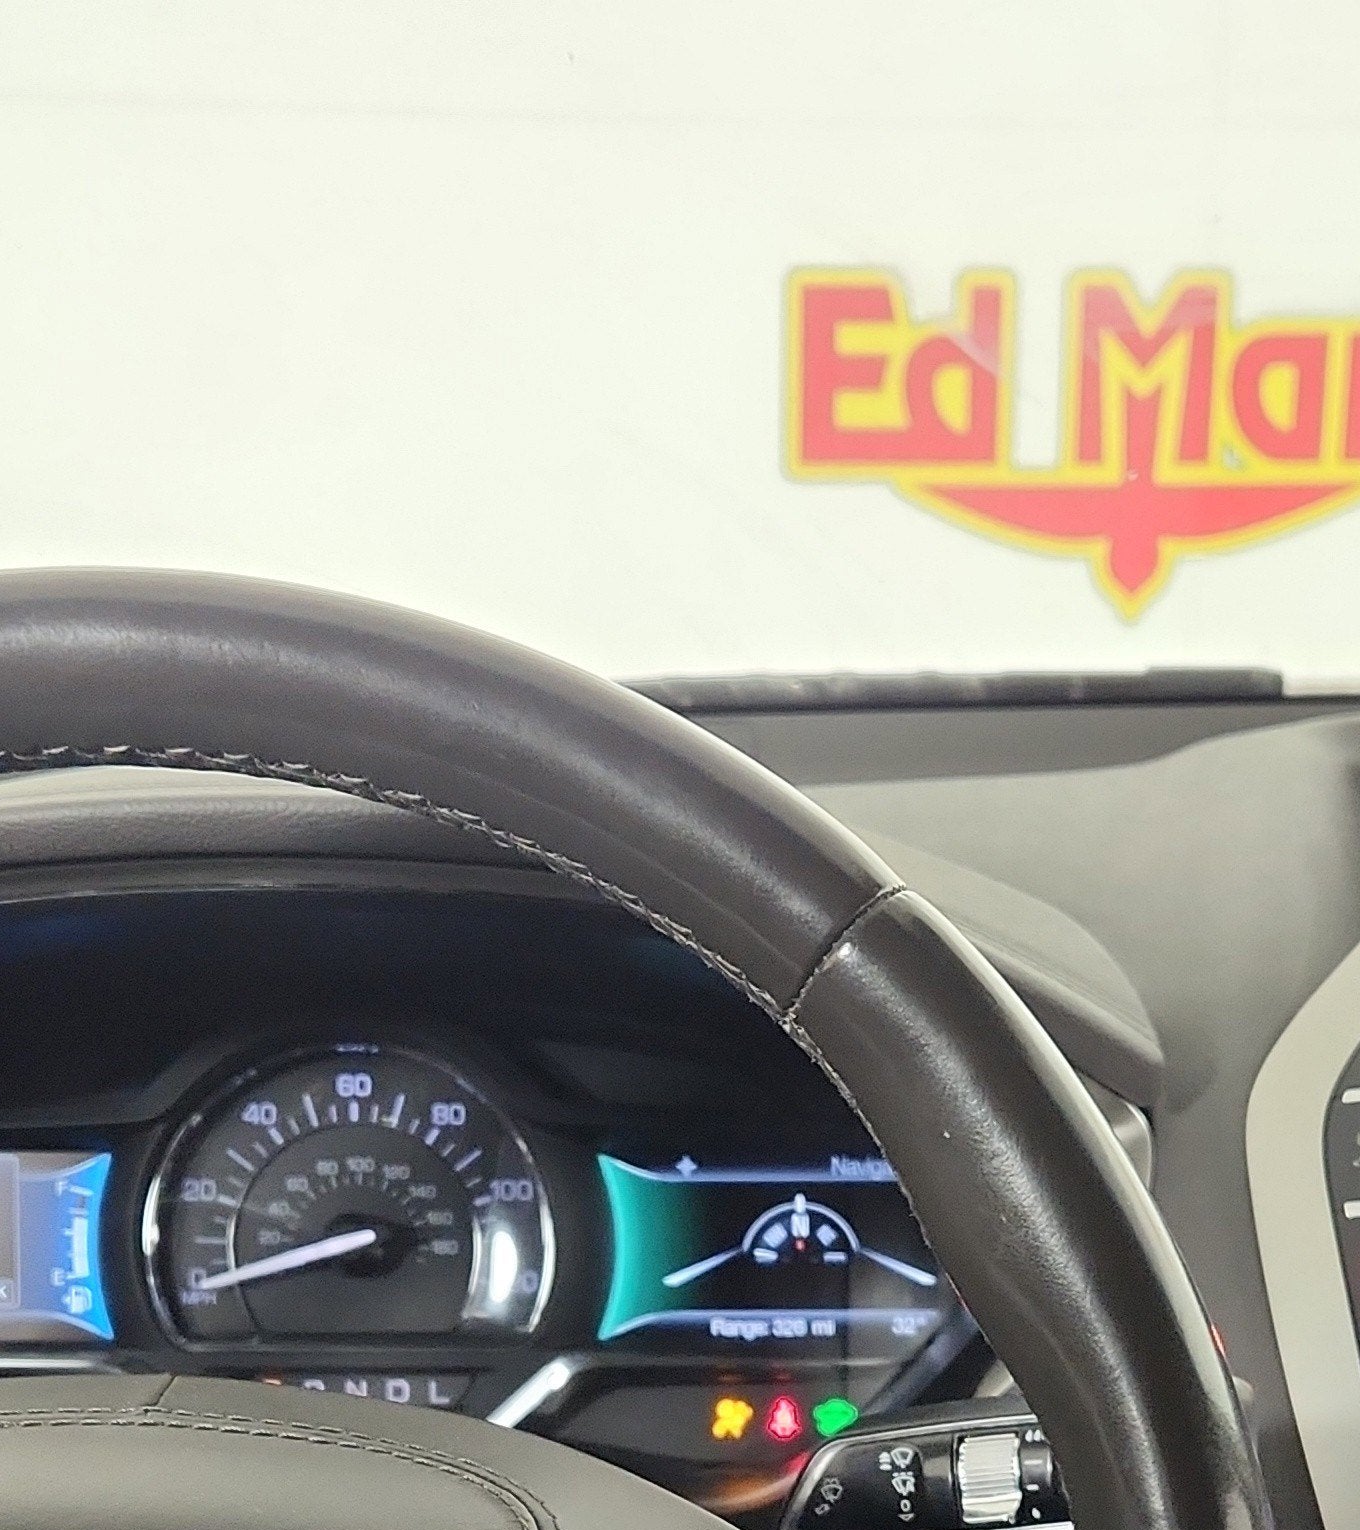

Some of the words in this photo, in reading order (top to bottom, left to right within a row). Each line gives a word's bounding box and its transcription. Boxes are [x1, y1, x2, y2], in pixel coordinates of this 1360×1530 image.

[788, 267, 1015, 477] Ed
[335, 1073, 372, 1097] 60
[242, 1102, 277, 1125] 40
[181, 1179, 217, 1200] 20
[489, 1181, 534, 1200] 100
[386, 1378, 411, 1403] D
[428, 1380, 450, 1405] L
